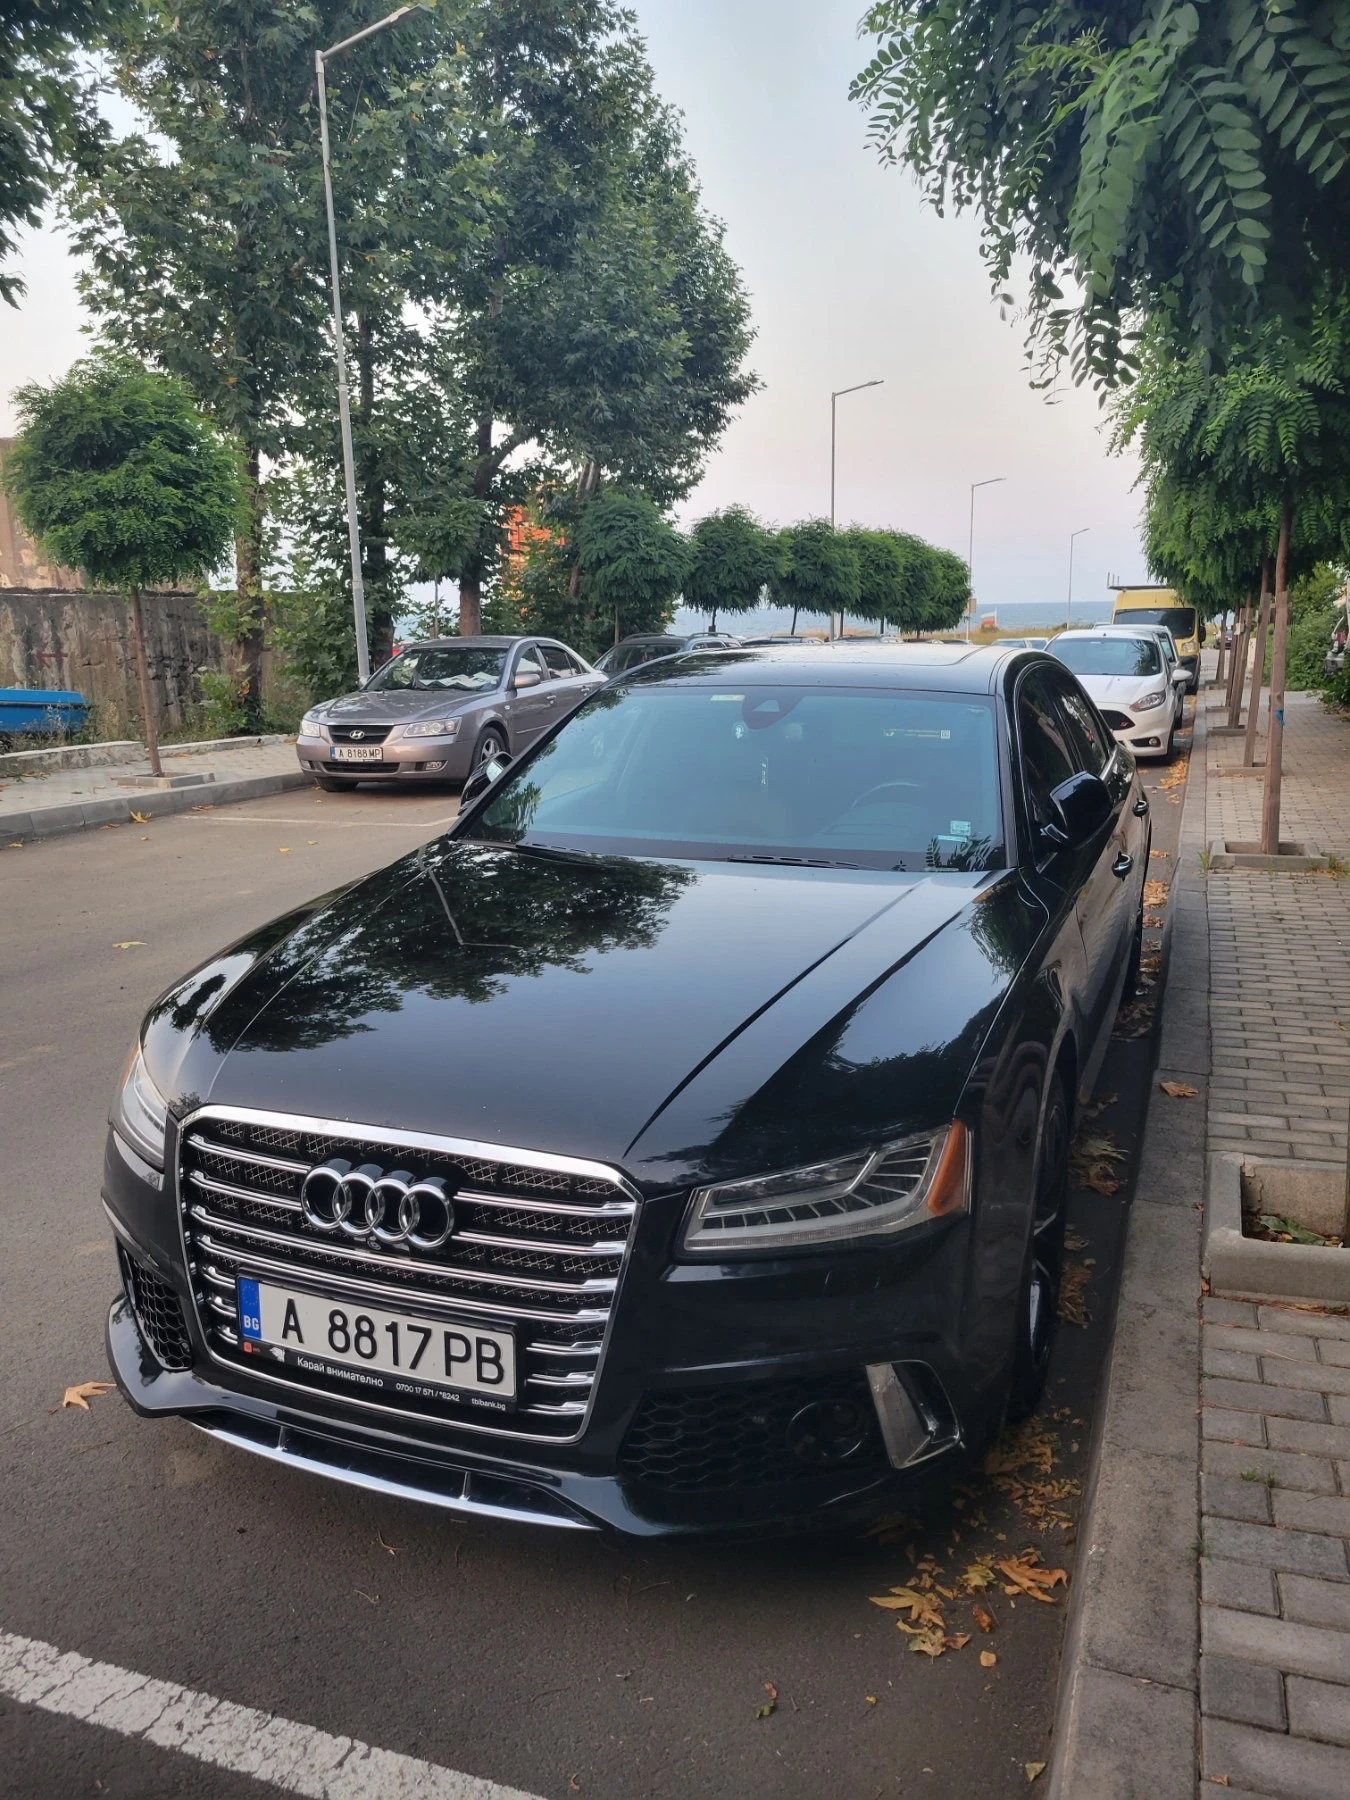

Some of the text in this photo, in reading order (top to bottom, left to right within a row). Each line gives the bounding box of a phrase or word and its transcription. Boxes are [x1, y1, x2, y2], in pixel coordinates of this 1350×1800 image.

[243, 1315, 260, 1331] BG
[281, 1298, 505, 1386] A 8817 PB
[297, 1356, 384, 1387] Карай внимателно
[396, 1382, 414, 1393] 0700
[415, 1386, 422, 1394] 17
